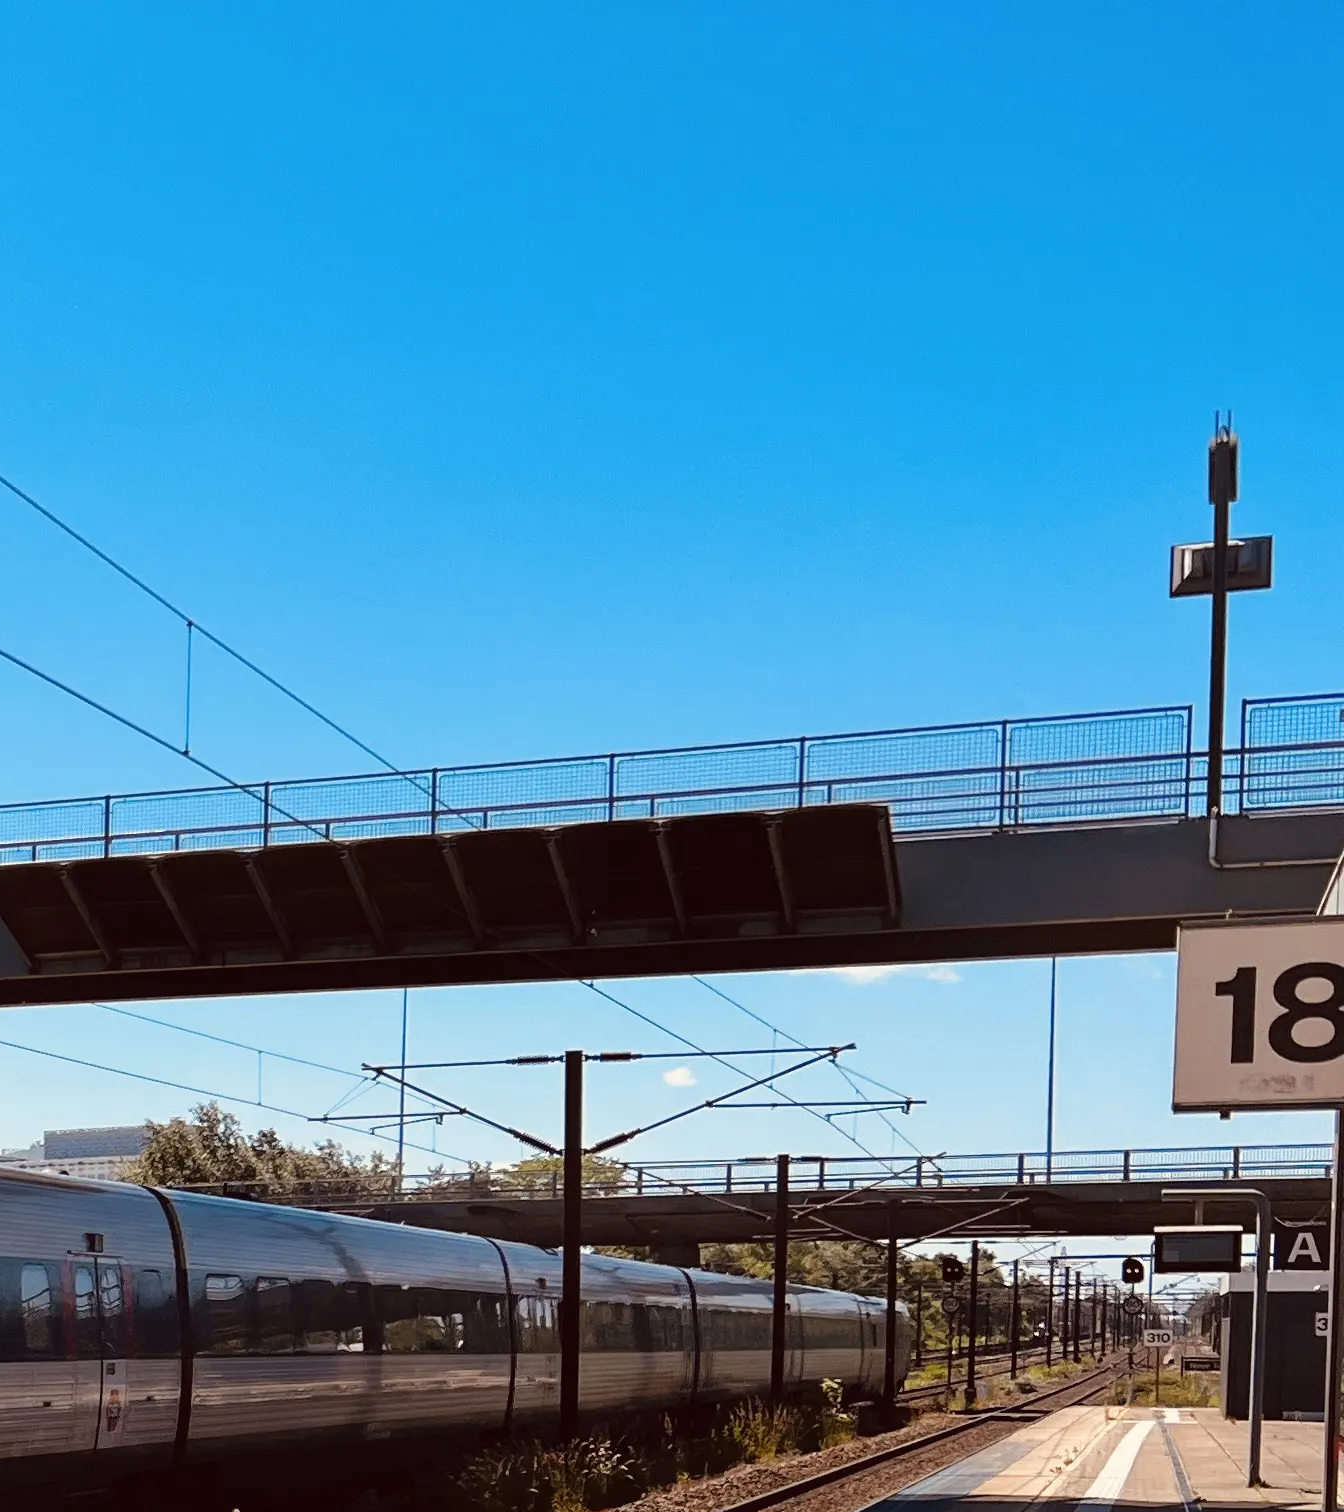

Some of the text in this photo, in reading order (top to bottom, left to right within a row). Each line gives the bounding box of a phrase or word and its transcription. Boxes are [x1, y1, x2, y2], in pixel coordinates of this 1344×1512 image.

[1215, 962, 1344, 1064] 18
[1287, 1232, 1322, 1263] A
[1146, 1332, 1171, 1343] 310
